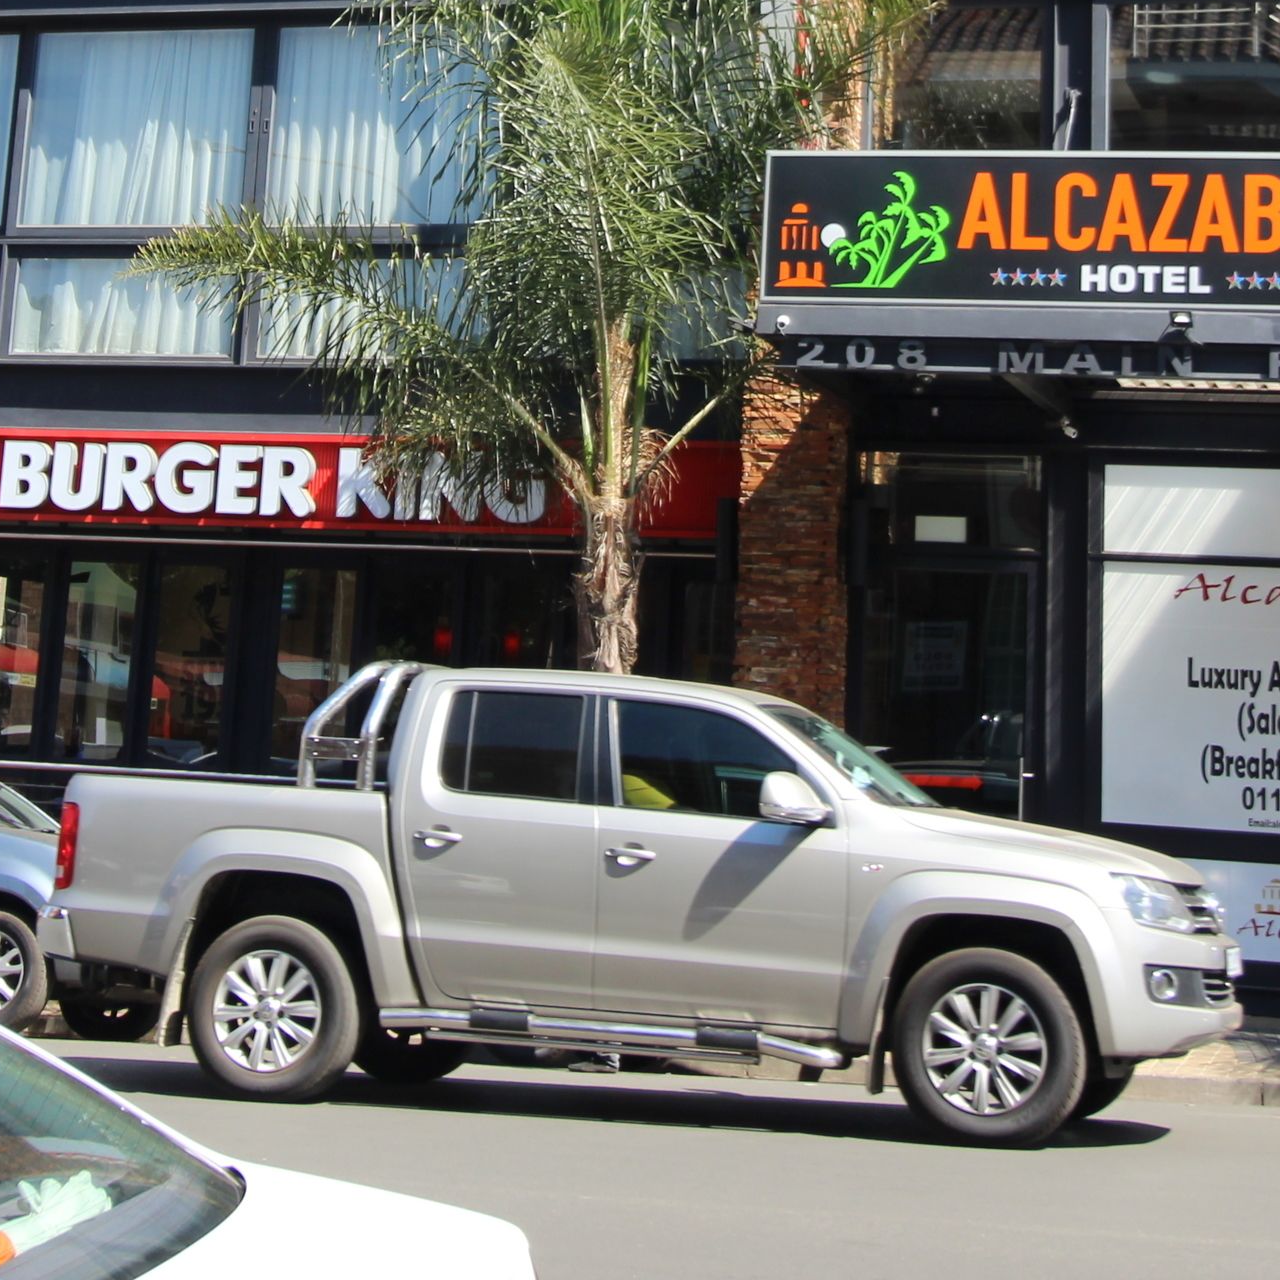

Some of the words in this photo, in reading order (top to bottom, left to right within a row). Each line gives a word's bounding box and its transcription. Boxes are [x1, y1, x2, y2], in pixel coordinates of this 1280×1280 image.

[1080, 265, 1212, 294] HOTEL
[796, 337, 927, 369] 208
[998, 341, 1193, 377] MAIN
[1187, 657, 1261, 698] Luxury
